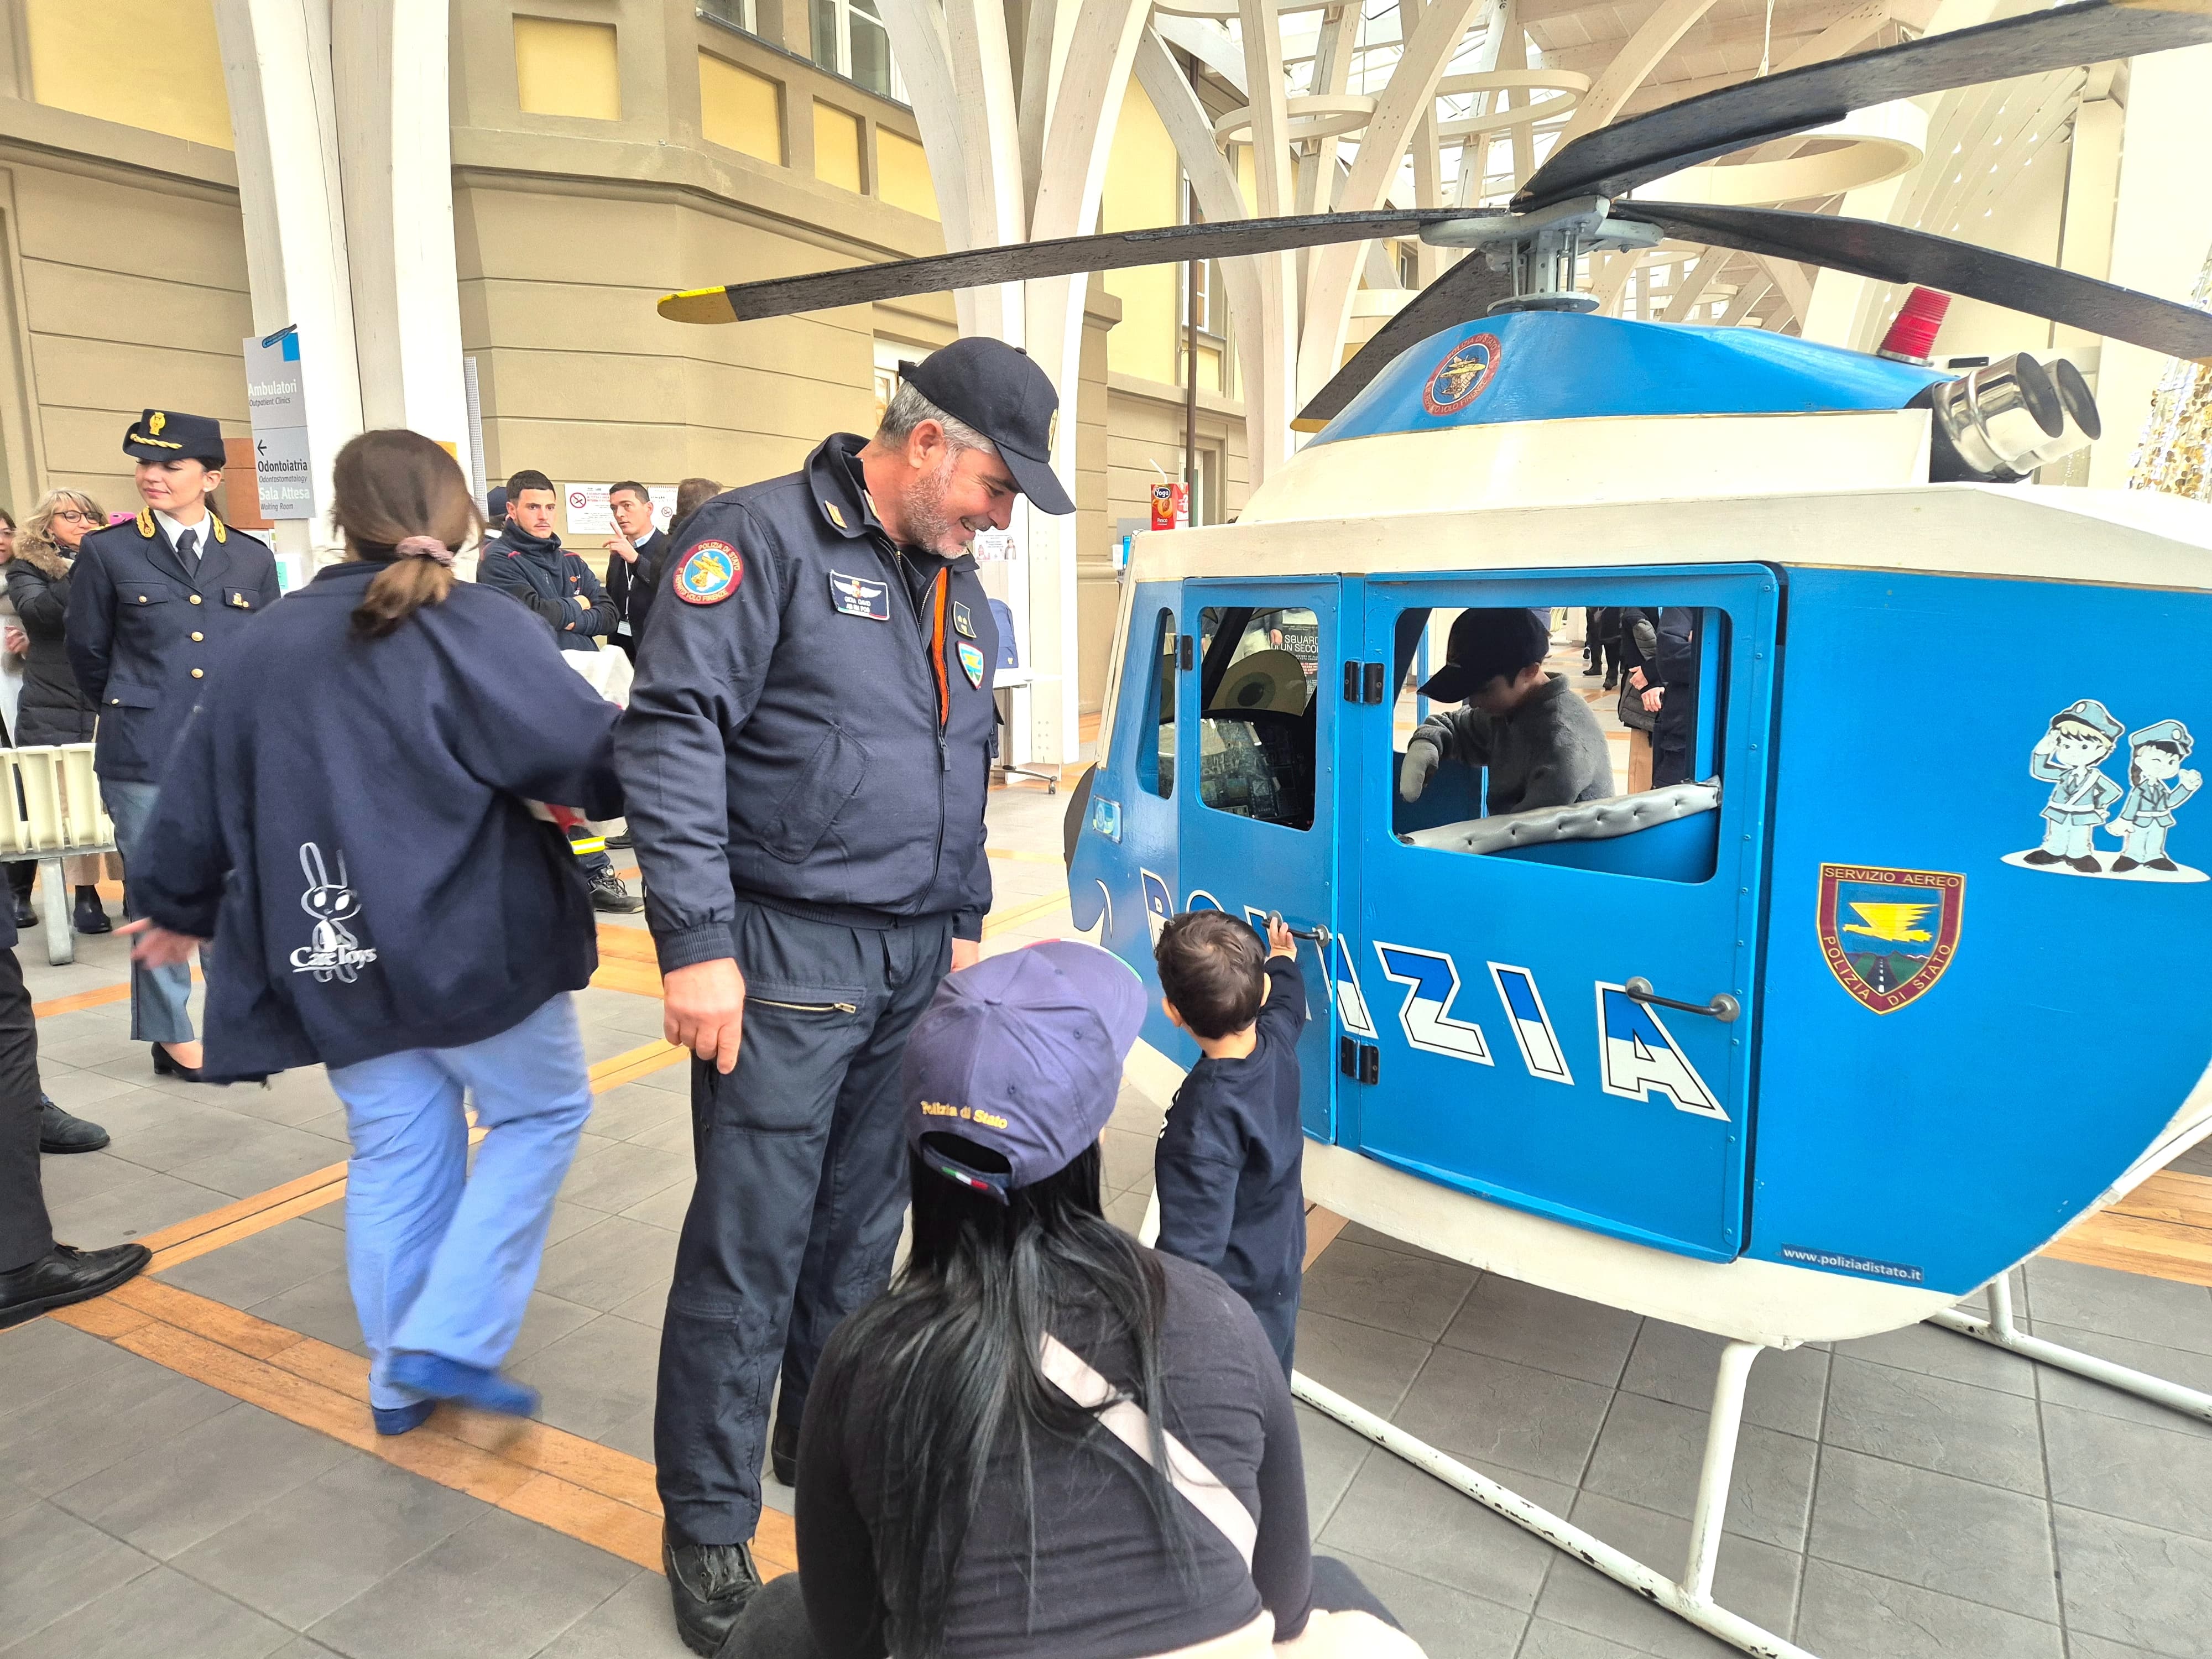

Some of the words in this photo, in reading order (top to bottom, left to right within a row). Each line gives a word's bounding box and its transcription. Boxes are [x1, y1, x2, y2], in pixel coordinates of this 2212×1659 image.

[248, 378, 297, 397] Ambulatori
[1460, 379, 1488, 405] FIRENZE
[249, 398, 274, 408] Outpatient
[275, 396, 291, 405] Clinics
[258, 458, 308, 472] Odontoiatria
[259, 486, 279, 500] Sala
[281, 486, 310, 500] Attesa
[1156, 489, 1169, 497] Yoga
[260, 503, 279, 512] Waiting
[698, 541, 723, 551] POLIZIA
[722, 545, 731, 553] DI
[728, 551, 740, 571] STATO
[686, 591, 702, 601] VOLO
[702, 589, 729, 602] FIRENZE
[1281, 643, 1292, 651] UN
[1824, 867, 1896, 882] SERVIZIO
[1902, 874, 1959, 888] AEREO
[1823, 936, 1870, 1000] POLIZIA
[1886, 992, 1907, 1006] DI
[1912, 944, 1951, 990] STATO
[920, 1100, 958, 1117] Polizia
[960, 1106, 972, 1119] di
[973, 1109, 1009, 1129] Stato
[1783, 1247, 1922, 1281] www.poliziadistato.it
